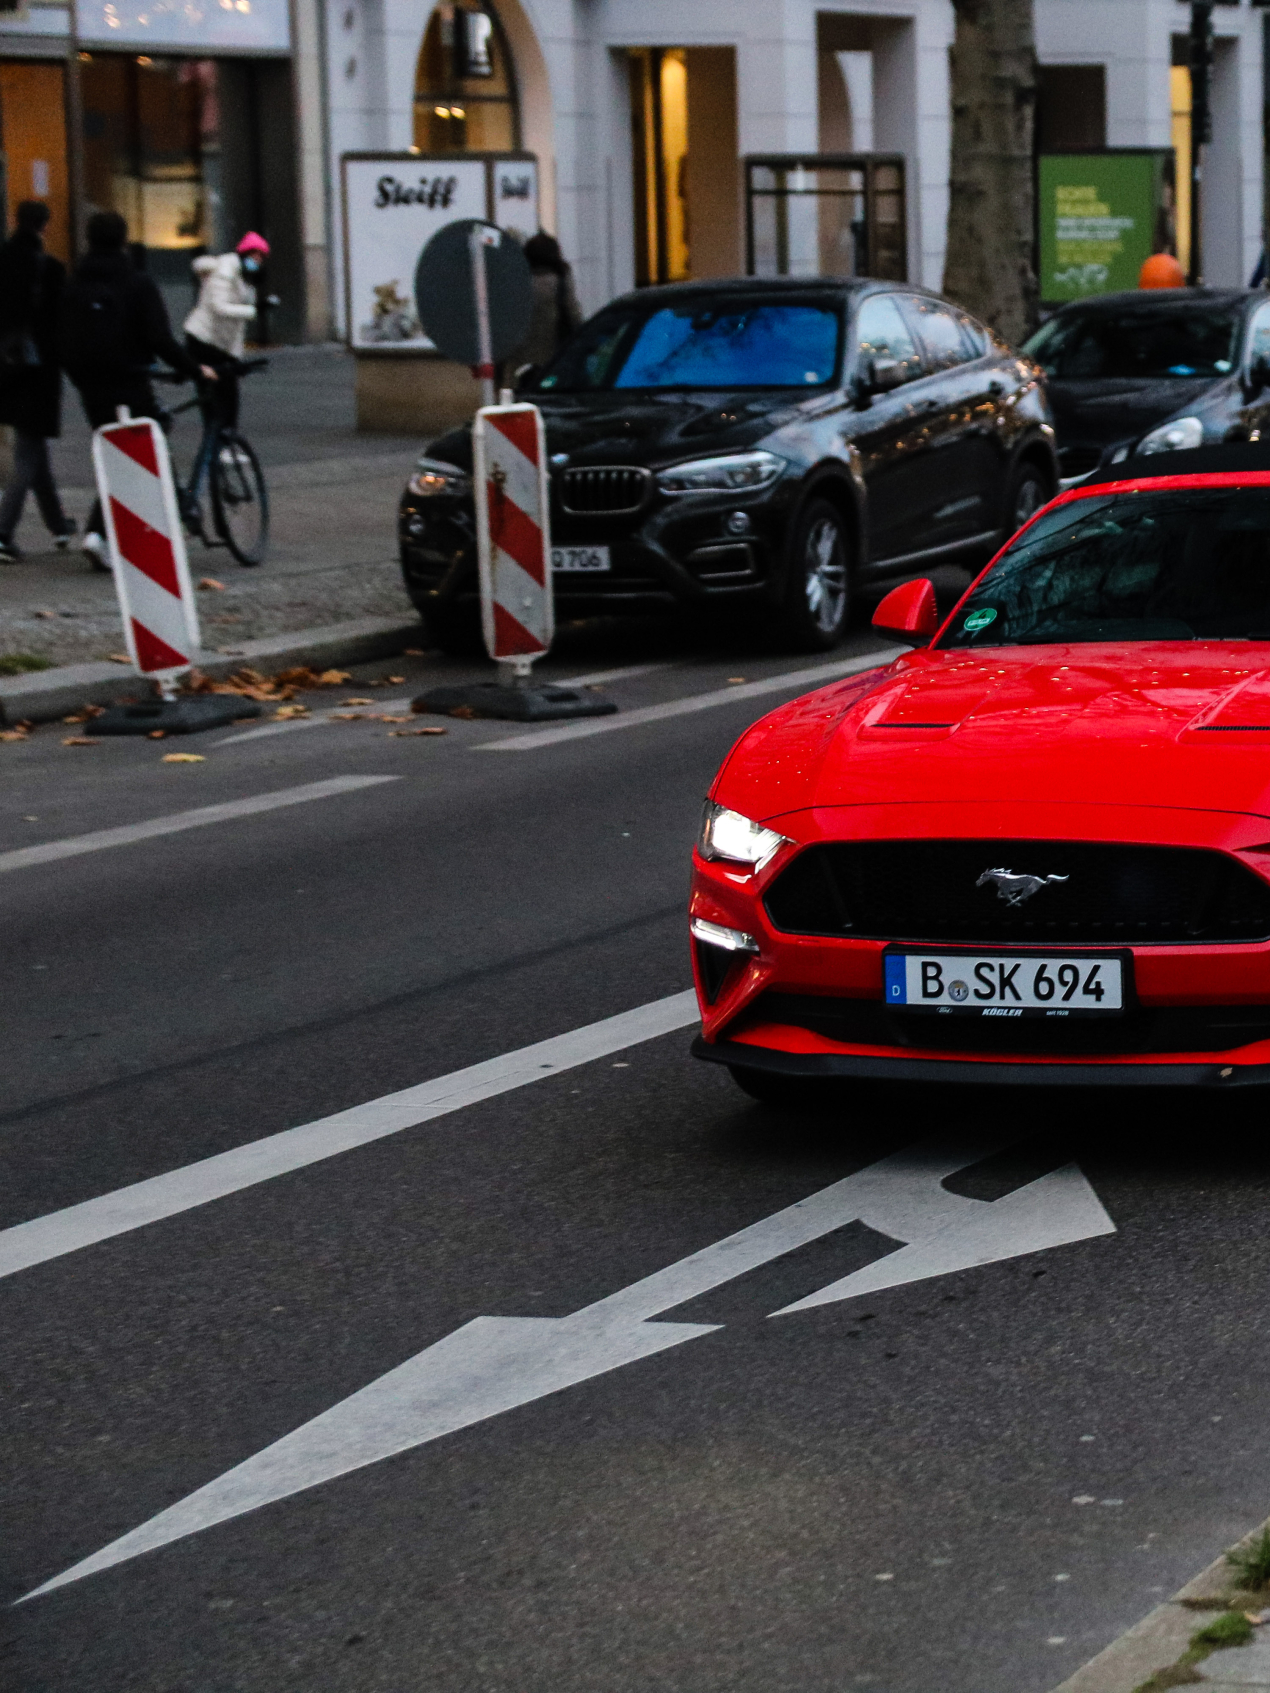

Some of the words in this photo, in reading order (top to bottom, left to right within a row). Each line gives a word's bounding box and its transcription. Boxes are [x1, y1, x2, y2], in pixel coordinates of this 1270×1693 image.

[892, 985, 900, 997] D
[921, 961, 945, 998] B
[973, 962, 1022, 1001] SK
[1033, 963, 1105, 1002] 694
